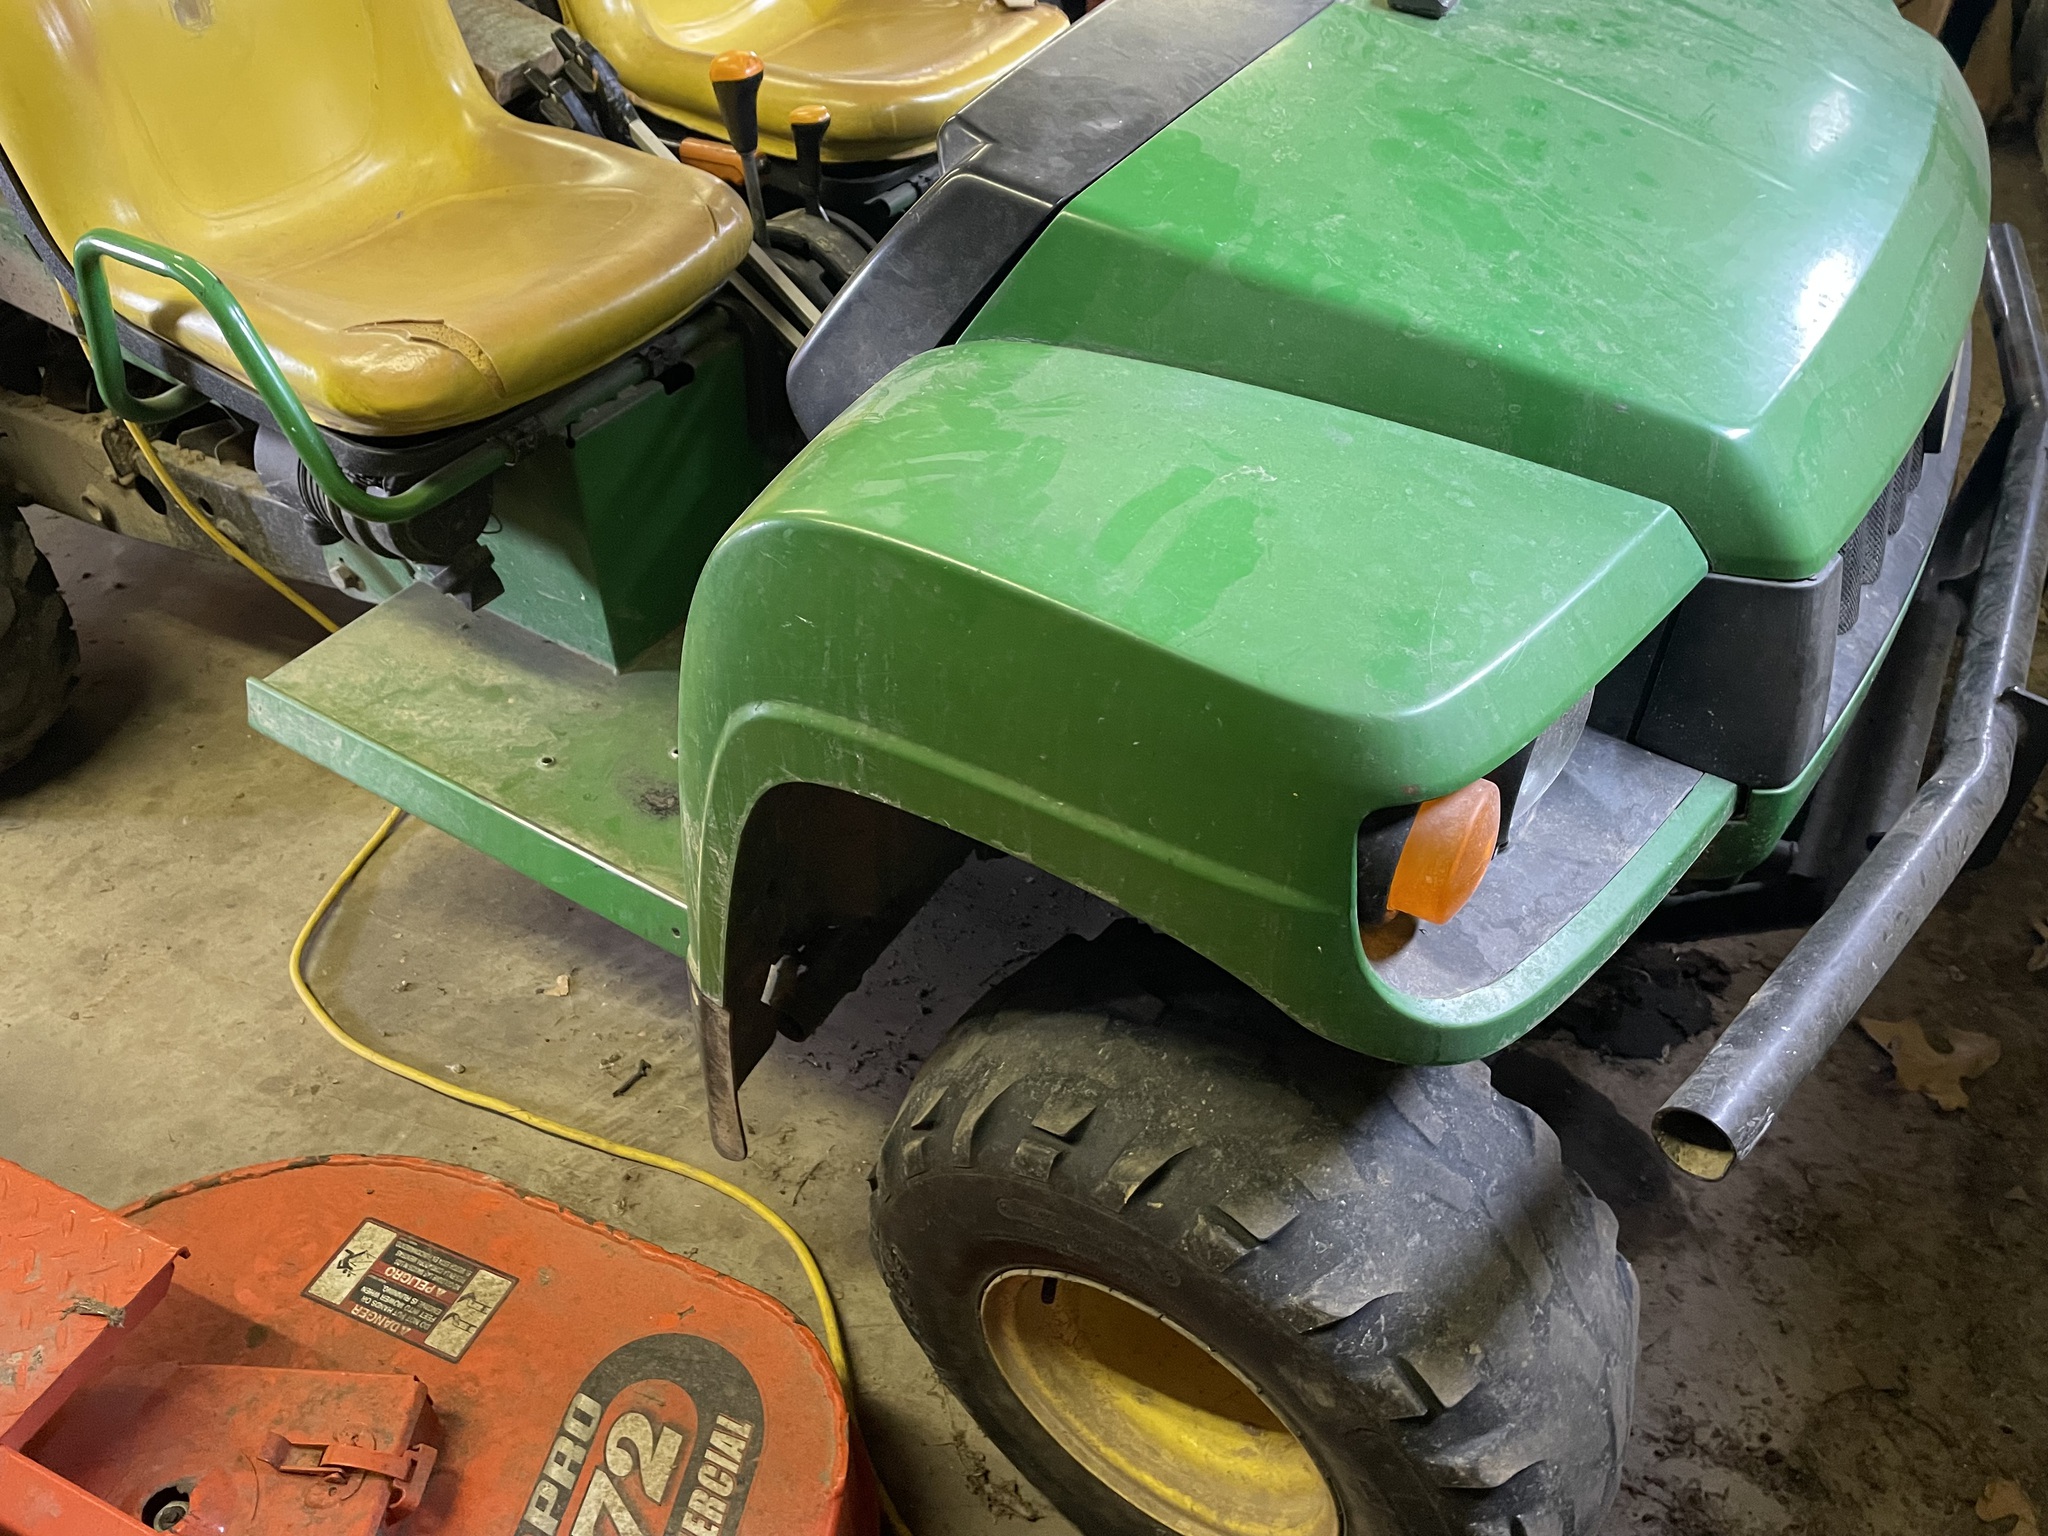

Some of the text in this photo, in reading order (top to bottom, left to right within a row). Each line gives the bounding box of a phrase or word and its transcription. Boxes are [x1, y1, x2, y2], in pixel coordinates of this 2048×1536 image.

[383, 1264, 436, 1295] PELIGRO
[350, 1303, 401, 1332] DANGER
[370, 1299, 394, 1314] HANDS
[418, 1310, 437, 1323] FEET
[523, 1392, 602, 1536] PRO
[570, 1412, 683, 1536] 72
[679, 1413, 755, 1536] ERCIAL
